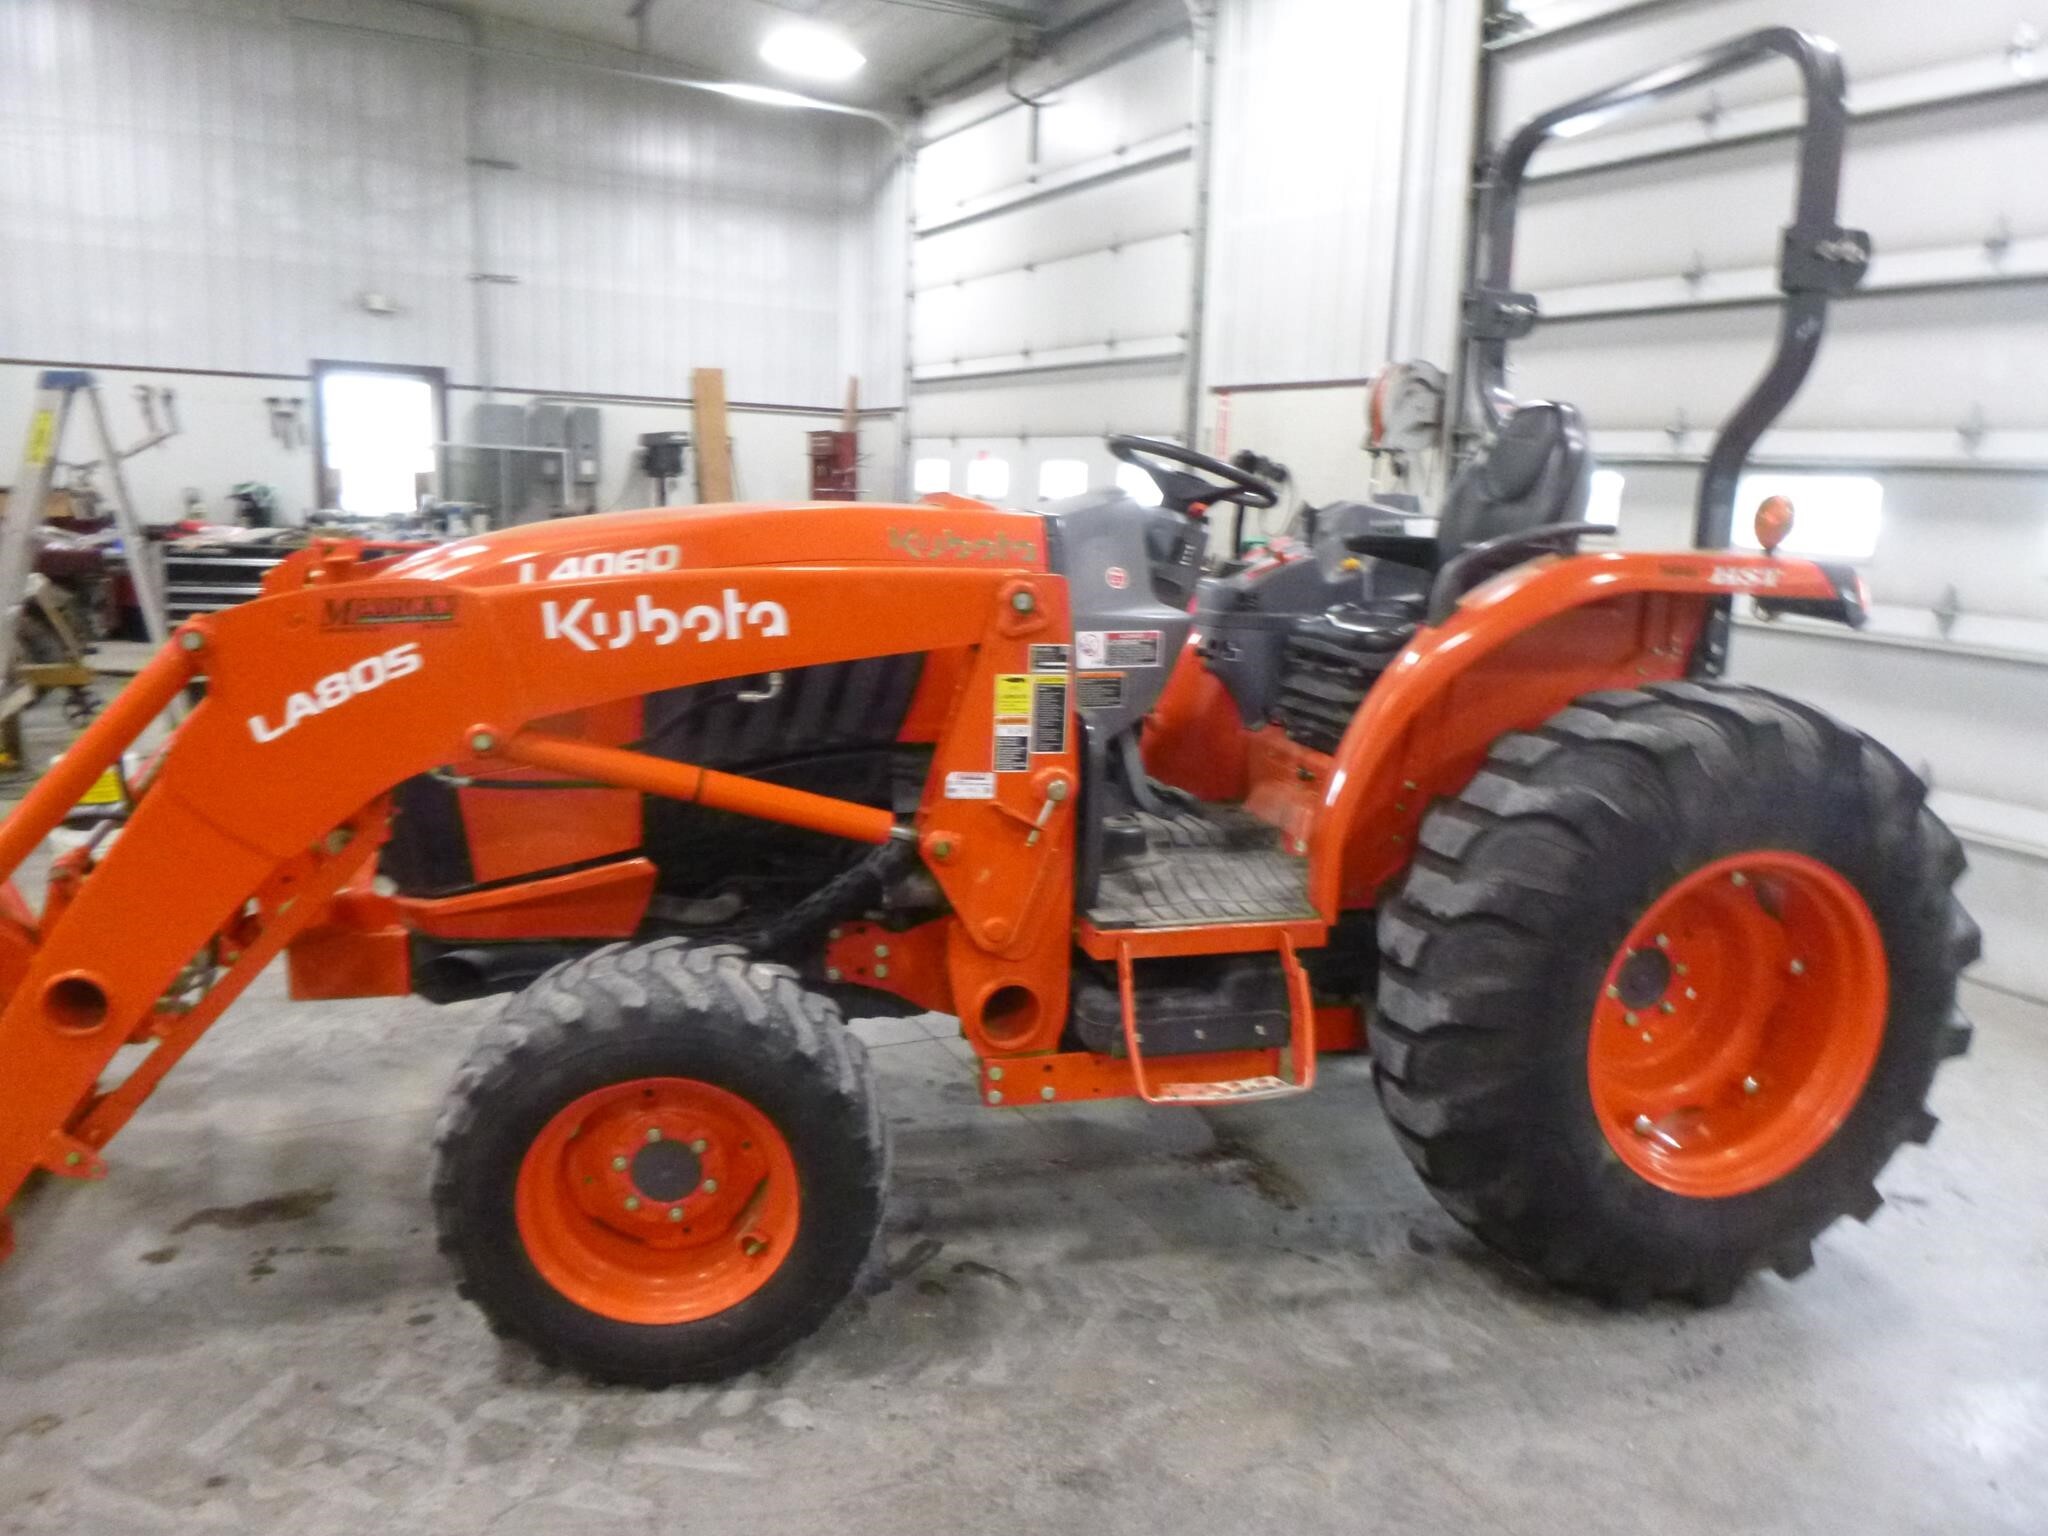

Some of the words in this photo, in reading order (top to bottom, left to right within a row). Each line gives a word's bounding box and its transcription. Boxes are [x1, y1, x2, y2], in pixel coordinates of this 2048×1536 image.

[887, 526, 1037, 561] Kubota
[541, 588, 789, 651] Kubota
[247, 641, 424, 743] LA805
